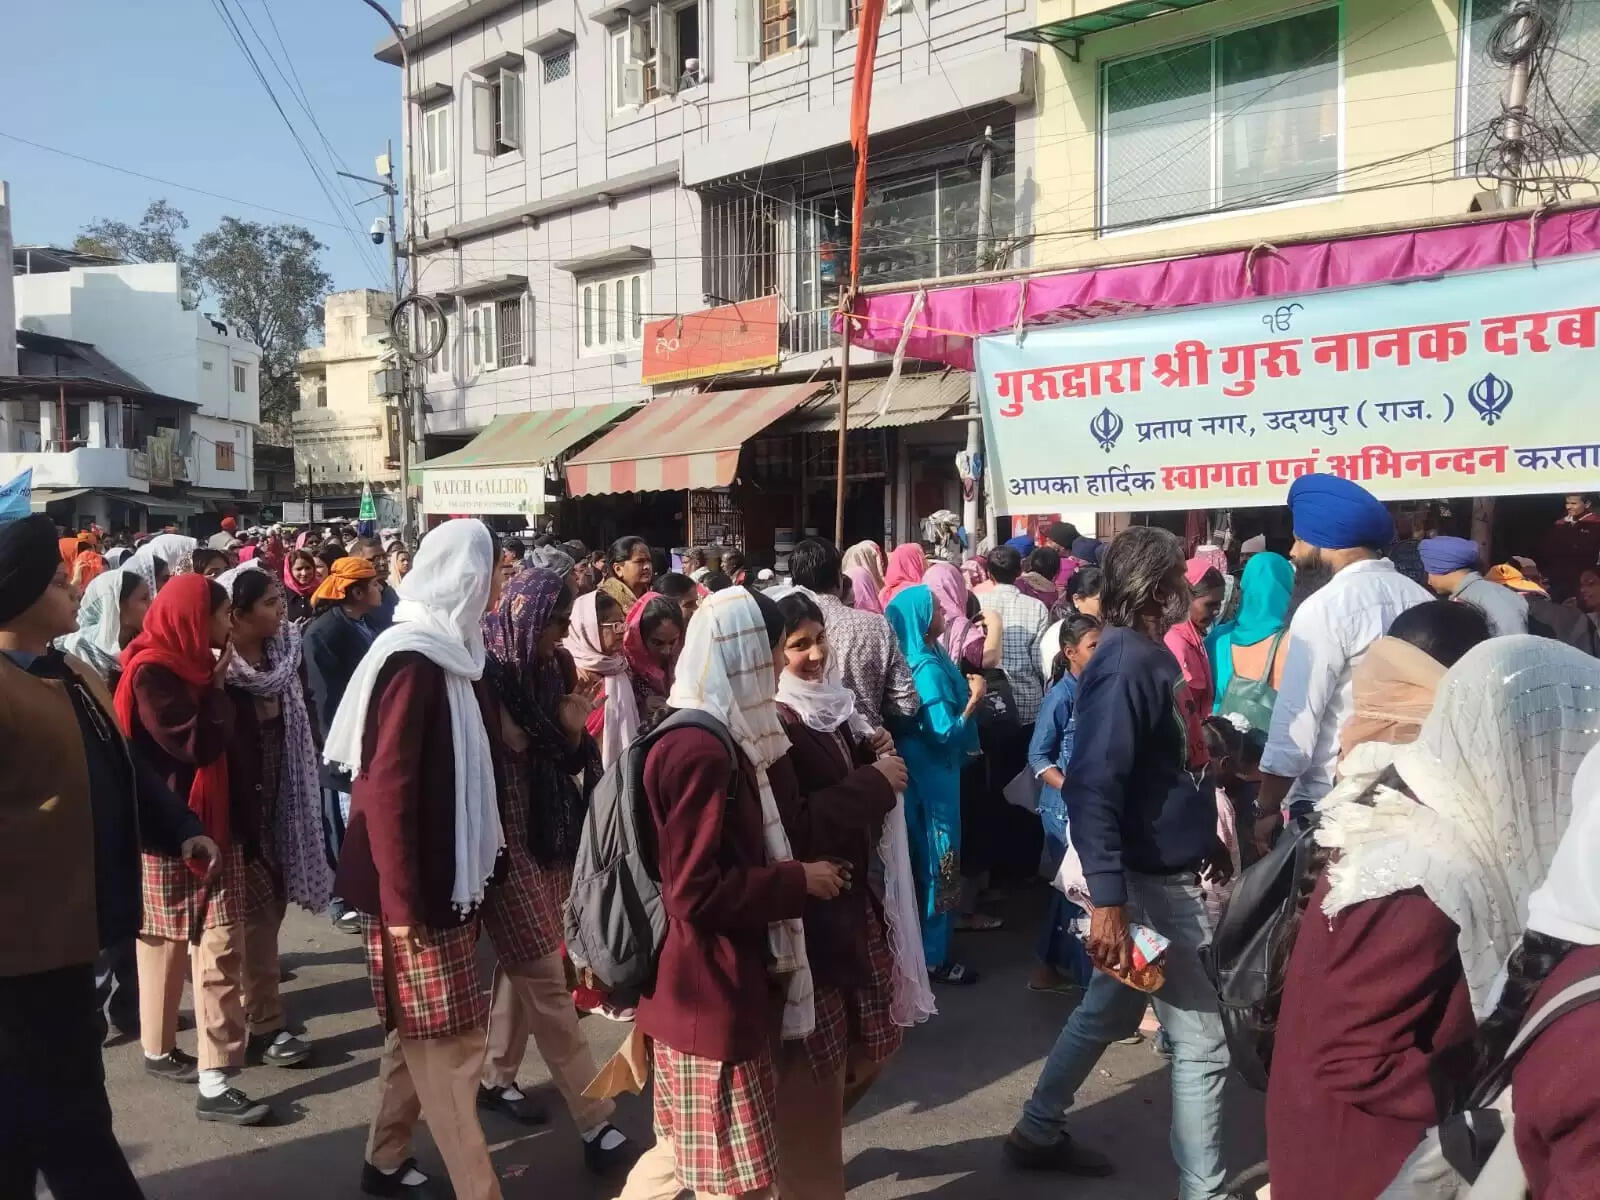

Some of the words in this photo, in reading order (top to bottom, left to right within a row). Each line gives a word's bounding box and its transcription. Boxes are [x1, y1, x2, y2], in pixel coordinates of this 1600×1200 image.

[994, 357, 1145, 417] गुरूद्वारा
[1152, 340, 1212, 388] श्री
[1220, 338, 1304, 396] गुरू
[1311, 321, 1471, 372] नानक
[1481, 306, 1600, 355] दरब
[1136, 419, 1192, 443] प्रताप
[1199, 414, 1256, 437] नगर,
[1263, 406, 1350, 435] उदयपुर
[432, 480, 472, 495] WATCH
[475, 478, 528, 494] GALLERY
[1009, 476, 1078, 496] आपका
[1084, 464, 1156, 496] हार्दिक
[1160, 461, 1261, 491] स्वागत
[1326, 445, 1509, 481] अभिनन्दन
[1514, 444, 1600, 471] करता
